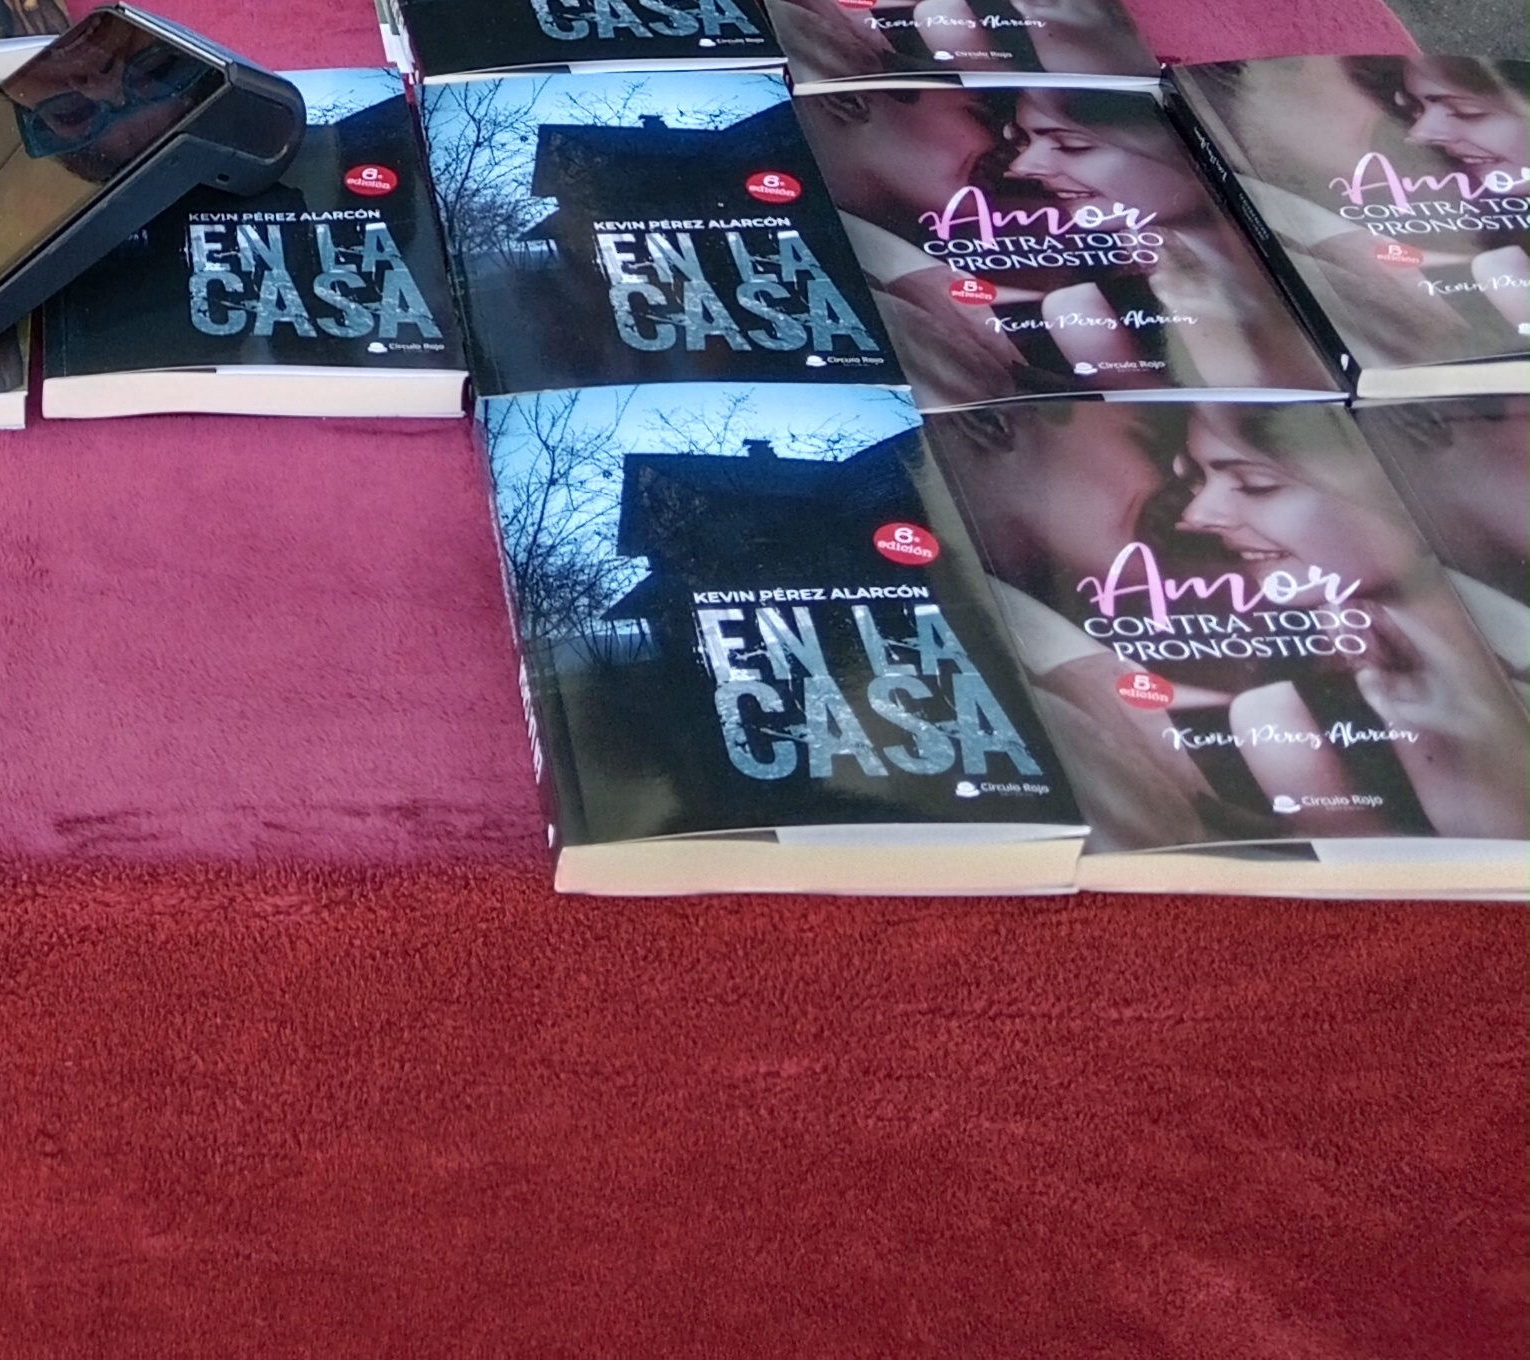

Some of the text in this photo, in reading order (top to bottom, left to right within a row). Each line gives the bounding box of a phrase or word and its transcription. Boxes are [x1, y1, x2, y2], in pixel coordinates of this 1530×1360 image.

[189, 208, 380, 222] KEVIN PÉREZ ALARCÓN
[594, 216, 790, 232] KEVIN PÉREZ ALARCÓN
[918, 185, 1157, 248] Amor
[1340, 201, 1480, 221] CONTRA
[185, 222, 402, 272] EN LA
[597, 230, 820, 285] EN LA
[923, 233, 1164, 257] CONTRA TODO
[946, 249, 1159, 271] PRONÓSTICO
[189, 270, 441, 338] CASA
[608, 281, 880, 352] CASA
[877, 540, 933, 558] edición
[694, 583, 929, 604] KEVIN PÉREZ ALARCÓN
[1076, 542, 1361, 633] Amor
[1084, 608, 1372, 639] CONTRA TODO
[694, 604, 969, 681] EN LA
[1114, 633, 1367, 663] PRONÓSTICO
[714, 676, 1043, 779] CASA
[1163, 727, 1243, 751] Kevin
